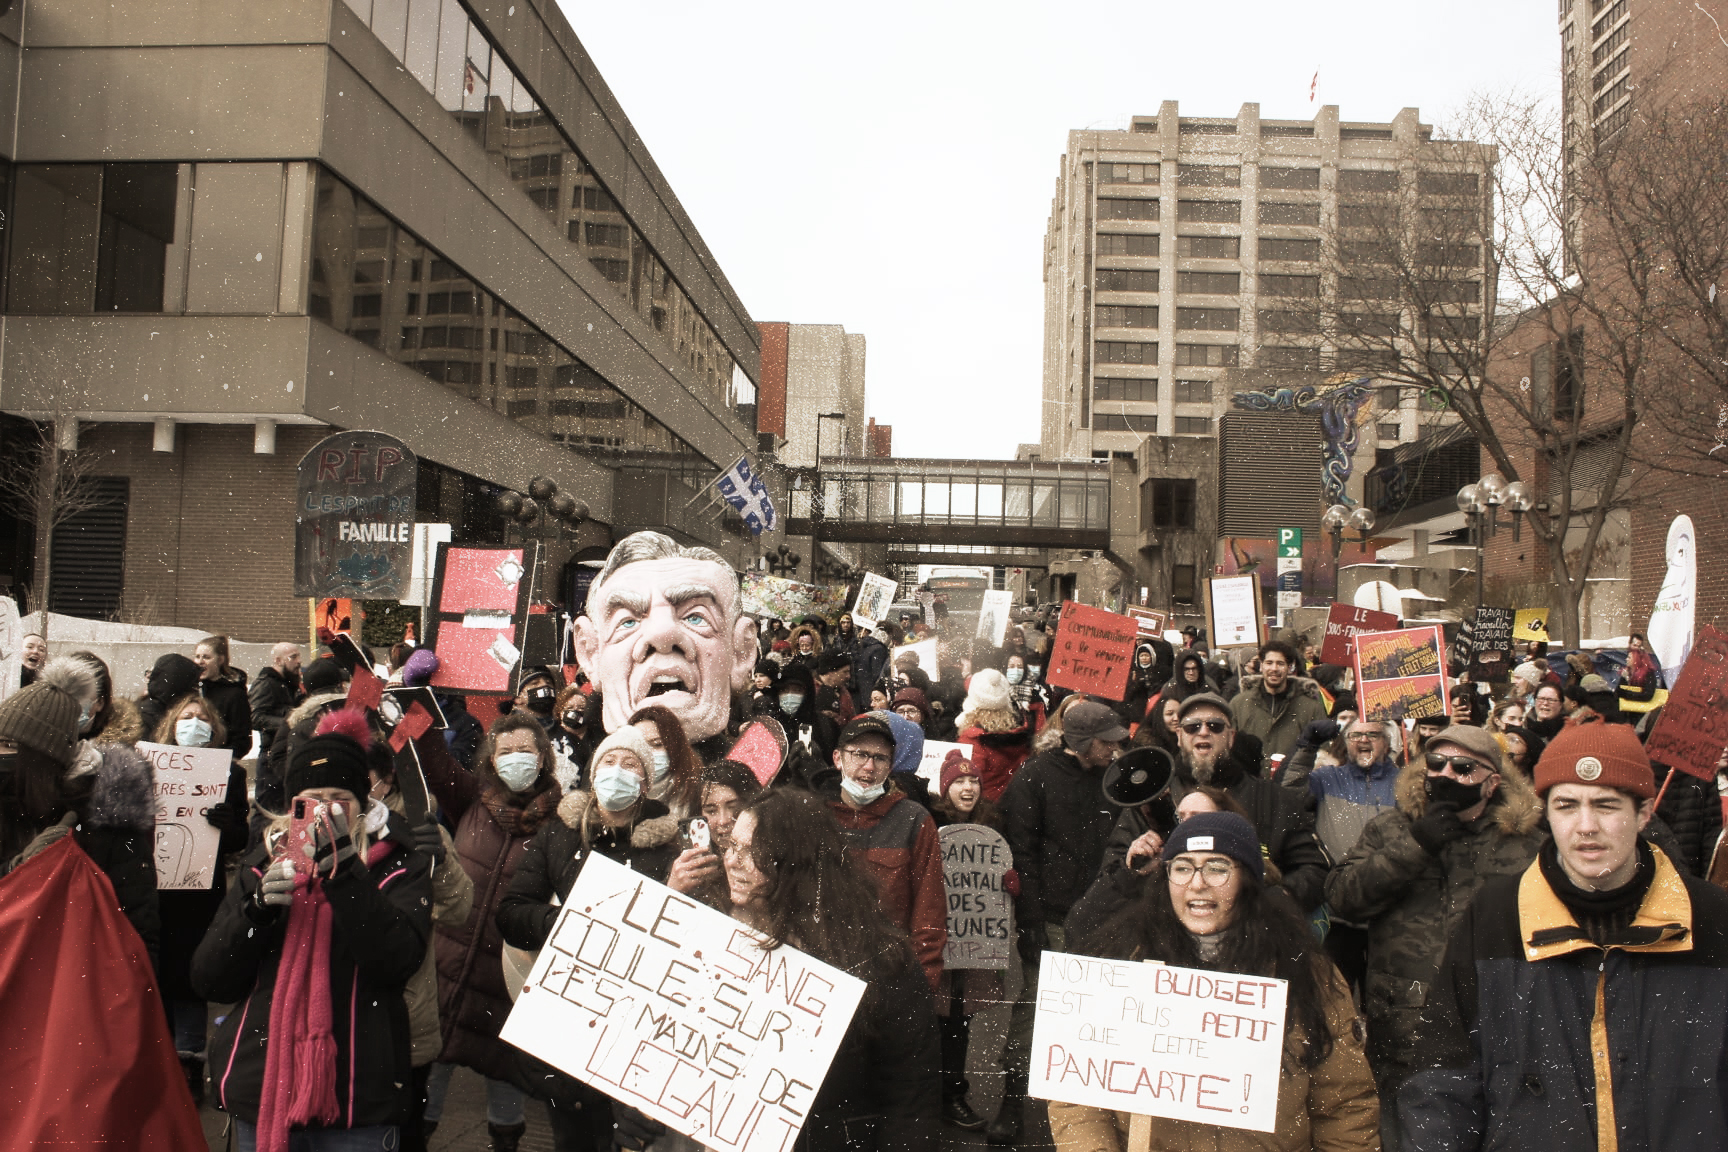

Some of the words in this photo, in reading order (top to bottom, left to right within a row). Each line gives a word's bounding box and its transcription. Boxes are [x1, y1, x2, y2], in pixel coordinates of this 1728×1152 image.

[317, 446, 401, 485] RIP
[338, 521, 410, 543] FAMILLE
[1281, 529, 1294, 545] P
[1354, 608, 1368, 622] LE
[1476, 608, 1511, 620] TRAVAIL
[1473, 629, 1510, 640] TRAVAIL
[1472, 640, 1491, 652] POUR
[1494, 640, 1508, 651] DES
[1397, 666, 1407, 677] LE
[1404, 659, 1421, 675] FILET
[152, 782, 185, 797] IRES
[191, 784, 227, 798] SONT
[176, 807, 194, 818] EN
[949, 893, 986, 913] DES
[946, 917, 1009, 940] EUNES
[622, 880, 697, 949] LE
[714, 929, 835, 1018] SANG
[550, 909, 700, 1008] COULE
[707, 982, 792, 1052] SUR
[1050, 955, 1130, 988] NOTRE
[1155, 968, 1278, 1009] BUDGET
[1039, 989, 1095, 1015] EST
[1122, 996, 1172, 1028] PLUS
[1201, 1011, 1278, 1042] PETIT
[540, 954, 623, 1018] LES
[635, 1003, 746, 1080] MAINS
[759, 1068, 813, 1117] DE
[1079, 1022, 1121, 1046] QUE
[1152, 1033, 1210, 1059] CETTE
